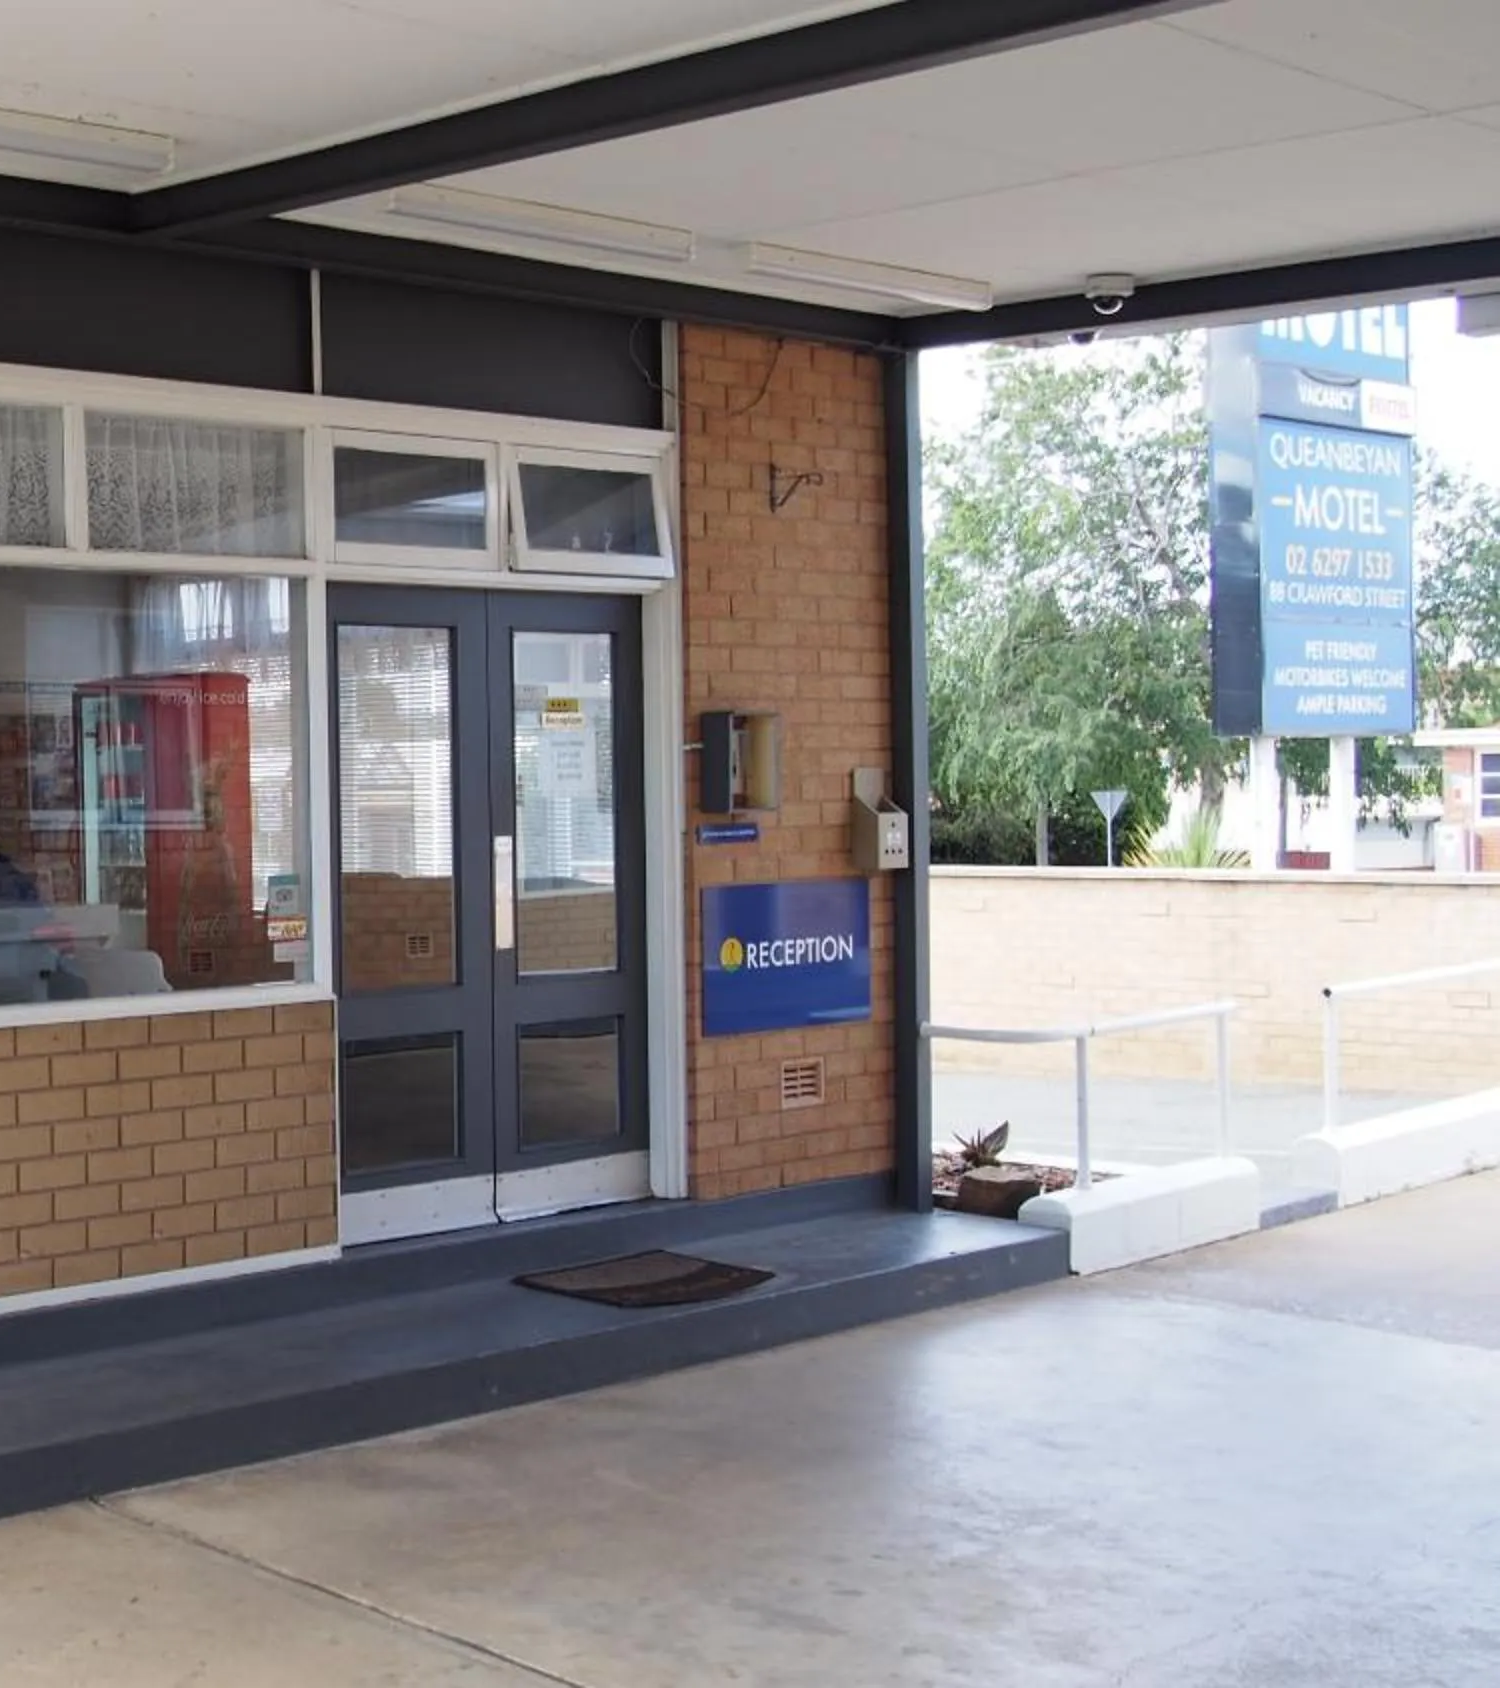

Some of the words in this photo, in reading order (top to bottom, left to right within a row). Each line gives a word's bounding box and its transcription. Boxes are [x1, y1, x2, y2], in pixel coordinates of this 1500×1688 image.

[1270, 432, 1401, 478] QUEANBEYAN
[1294, 484, 1386, 534] MOTEL
[1286, 544, 1308, 575] 02
[1312, 547, 1351, 577] 6297
[1358, 550, 1393, 581] 1533
[1288, 582, 1363, 607] CRAWFORD
[1365, 588, 1406, 609] STREET
[1305, 640, 1325, 661] PET
[1327, 641, 1377, 662] FRIENDLY
[1274, 667, 1349, 687] MOTORBIKES
[1351, 669, 1406, 689] WELCOME
[1296, 695, 1336, 715] AMPLE
[1337, 695, 1387, 716] PARKING
[747, 935, 853, 969] RECEPTION
